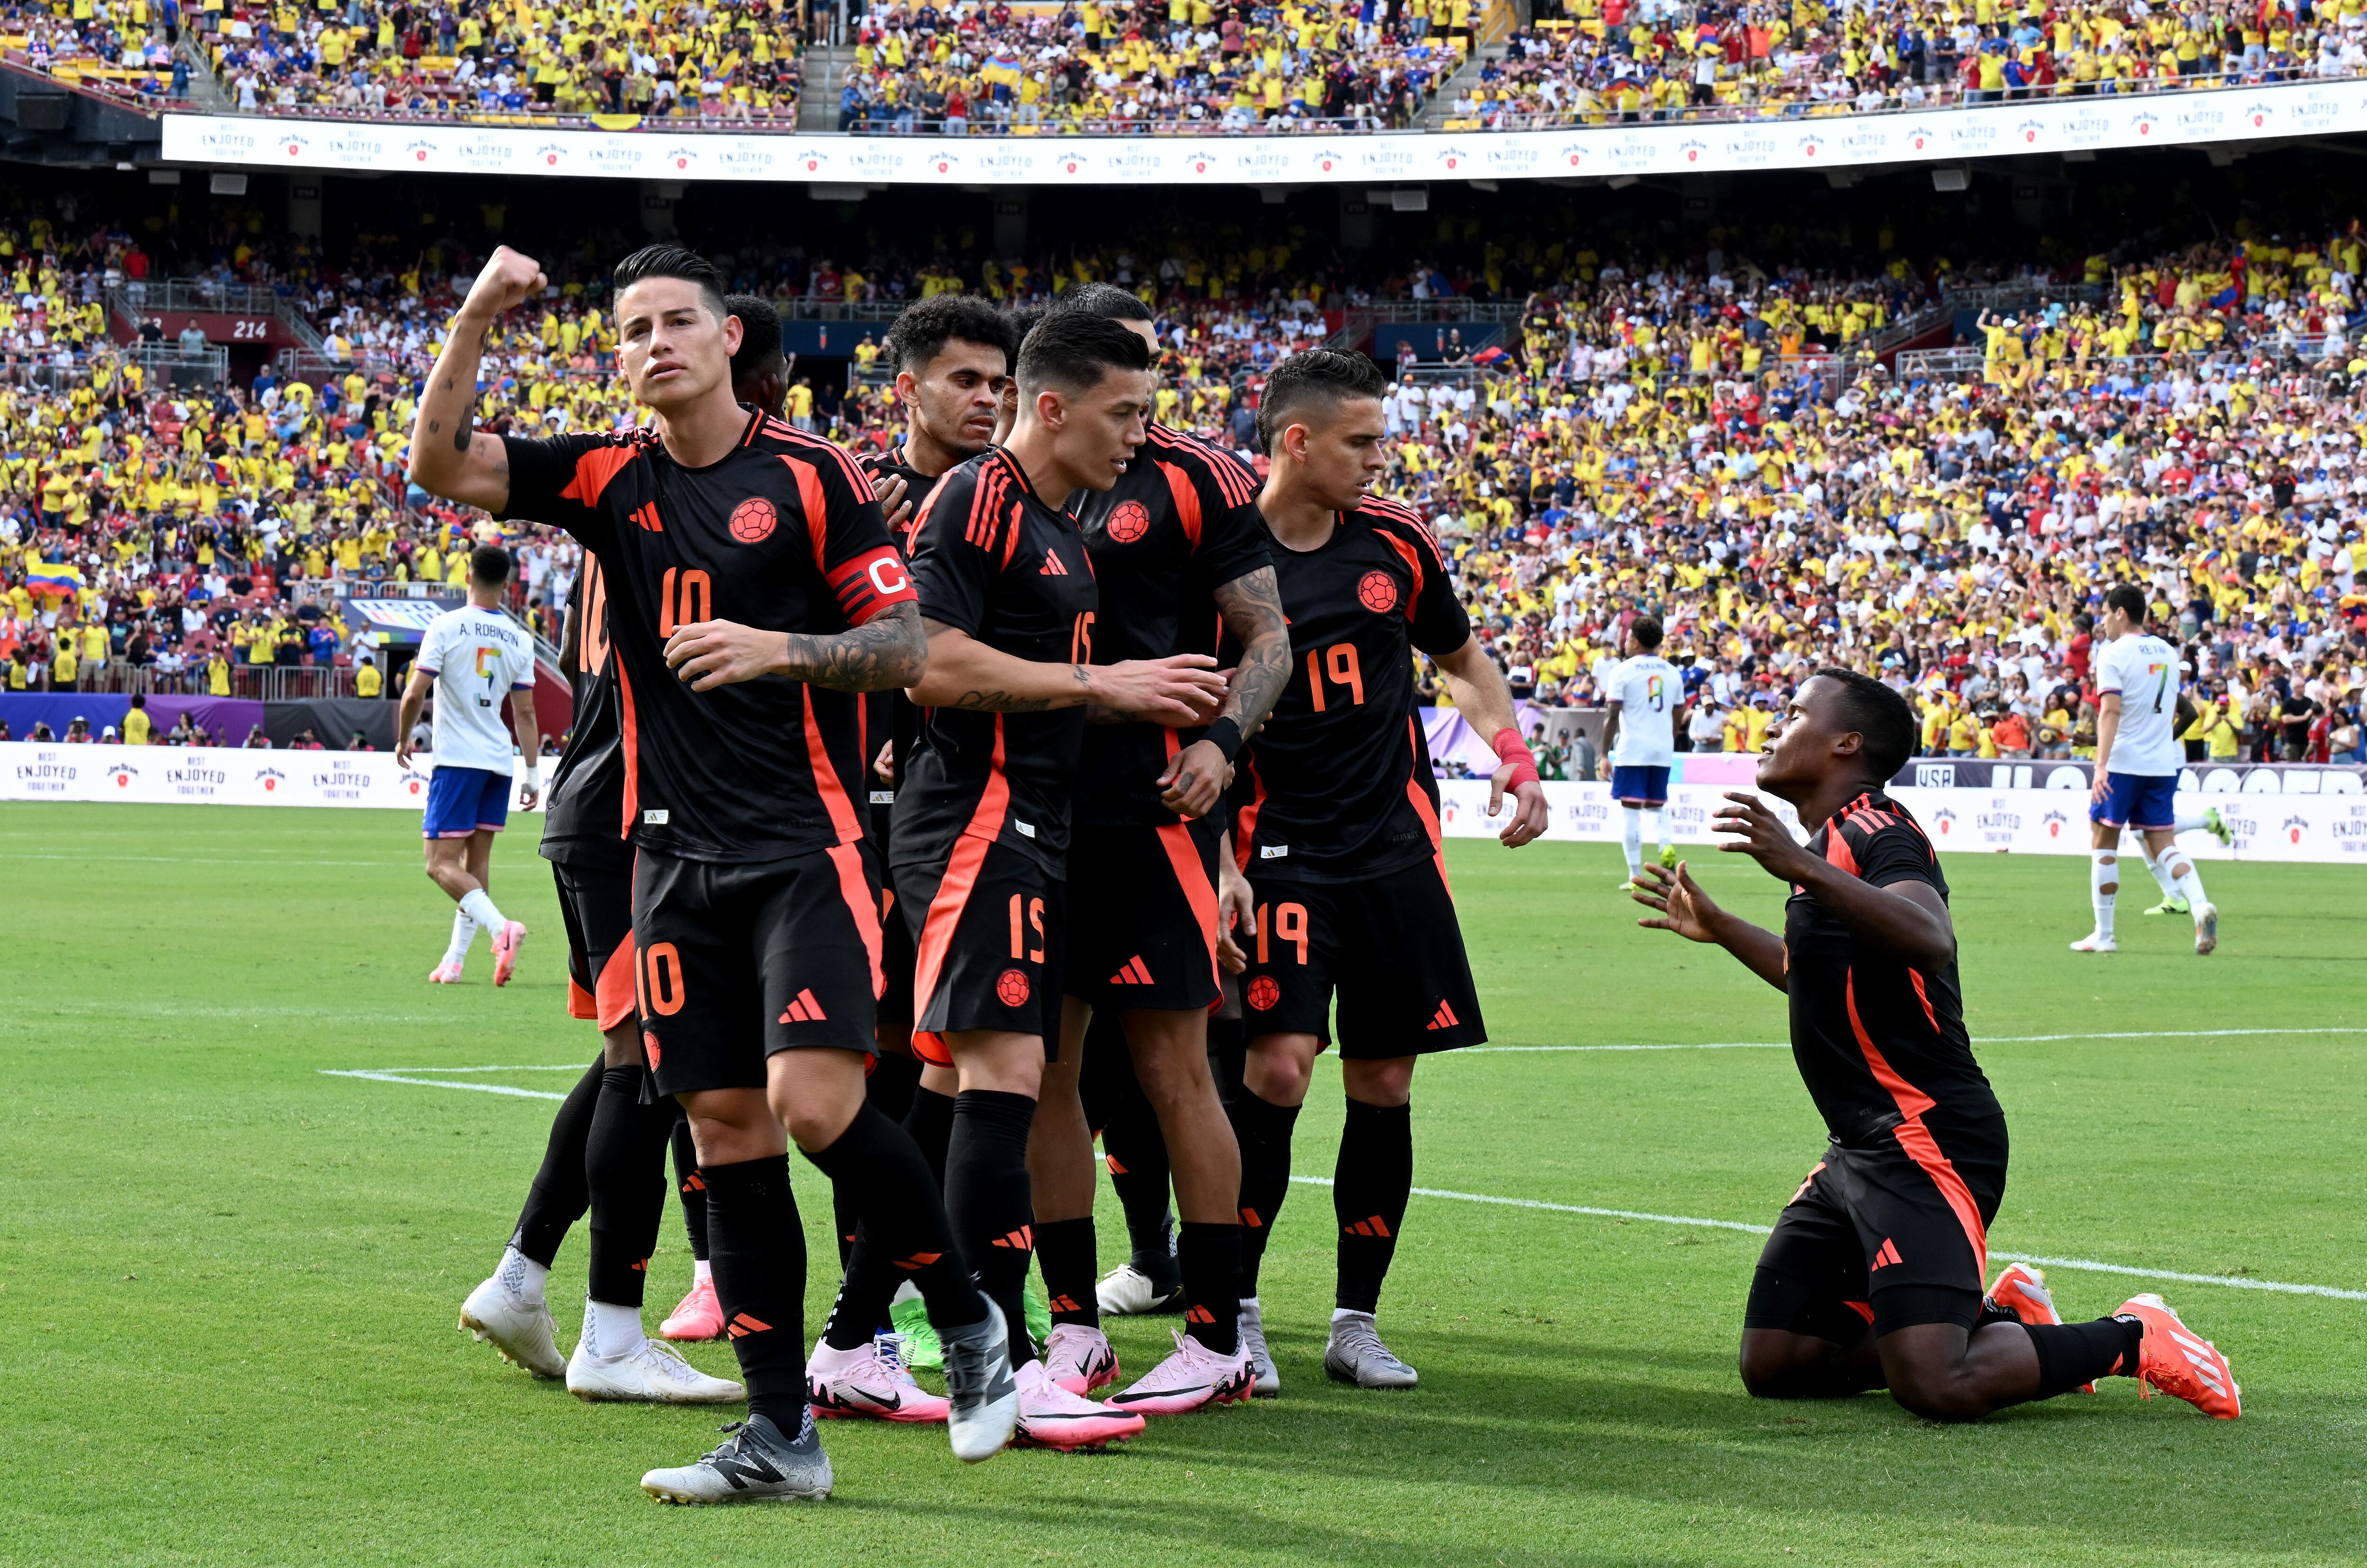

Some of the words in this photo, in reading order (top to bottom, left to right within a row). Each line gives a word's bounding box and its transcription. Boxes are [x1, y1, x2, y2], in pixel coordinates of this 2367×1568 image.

[2291, 103, 2338, 117] ENJOYED
[2178, 111, 2223, 126] ENJOYED
[1951, 127, 1996, 141] ENJOYED
[2063, 119, 2109, 134] ENJOYED
[202, 134, 254, 147] ENJOYED
[329, 141, 381, 154] ENJOYED
[1727, 141, 1775, 153] ENJOYED
[1842, 134, 1886, 148] ENJOYED
[459, 145, 512, 158] ENJOYED
[589, 149, 641, 162] ENJOYED
[719, 152, 772, 165] ENJOYED
[1362, 151, 1413, 165] ENJOYED
[1487, 150, 1538, 162] ENJOYED
[1608, 145, 1656, 159] ENJOYED
[850, 154, 902, 167] ENJOYED
[980, 156, 1032, 168] ENJOYED
[1108, 155, 1161, 167] ENJOYED
[1237, 155, 1288, 167] ENJOYED
[233, 321, 267, 339] 214
[868, 557, 906, 594] C
[660, 567, 711, 638] 10
[460, 623, 471, 635] A.
[475, 623, 518, 647] ROBINSON
[474, 647, 502, 707] 5
[1307, 643, 1363, 712] 19
[2149, 663, 2168, 713] 7
[17, 765, 77, 780] ENJOYED
[167, 769, 225, 785] ENJOYED
[1920, 769, 1951, 787] USA
[313, 773, 371, 788] ENJOYED
[1570, 804, 1607, 820] ENJOYED
[1977, 812, 2020, 829] ENJOYED
[2333, 820, 2367, 838] ENJOY
[1009, 893, 1045, 964] 15
[1257, 902, 1309, 966] 19
[636, 942, 685, 1021] 10
